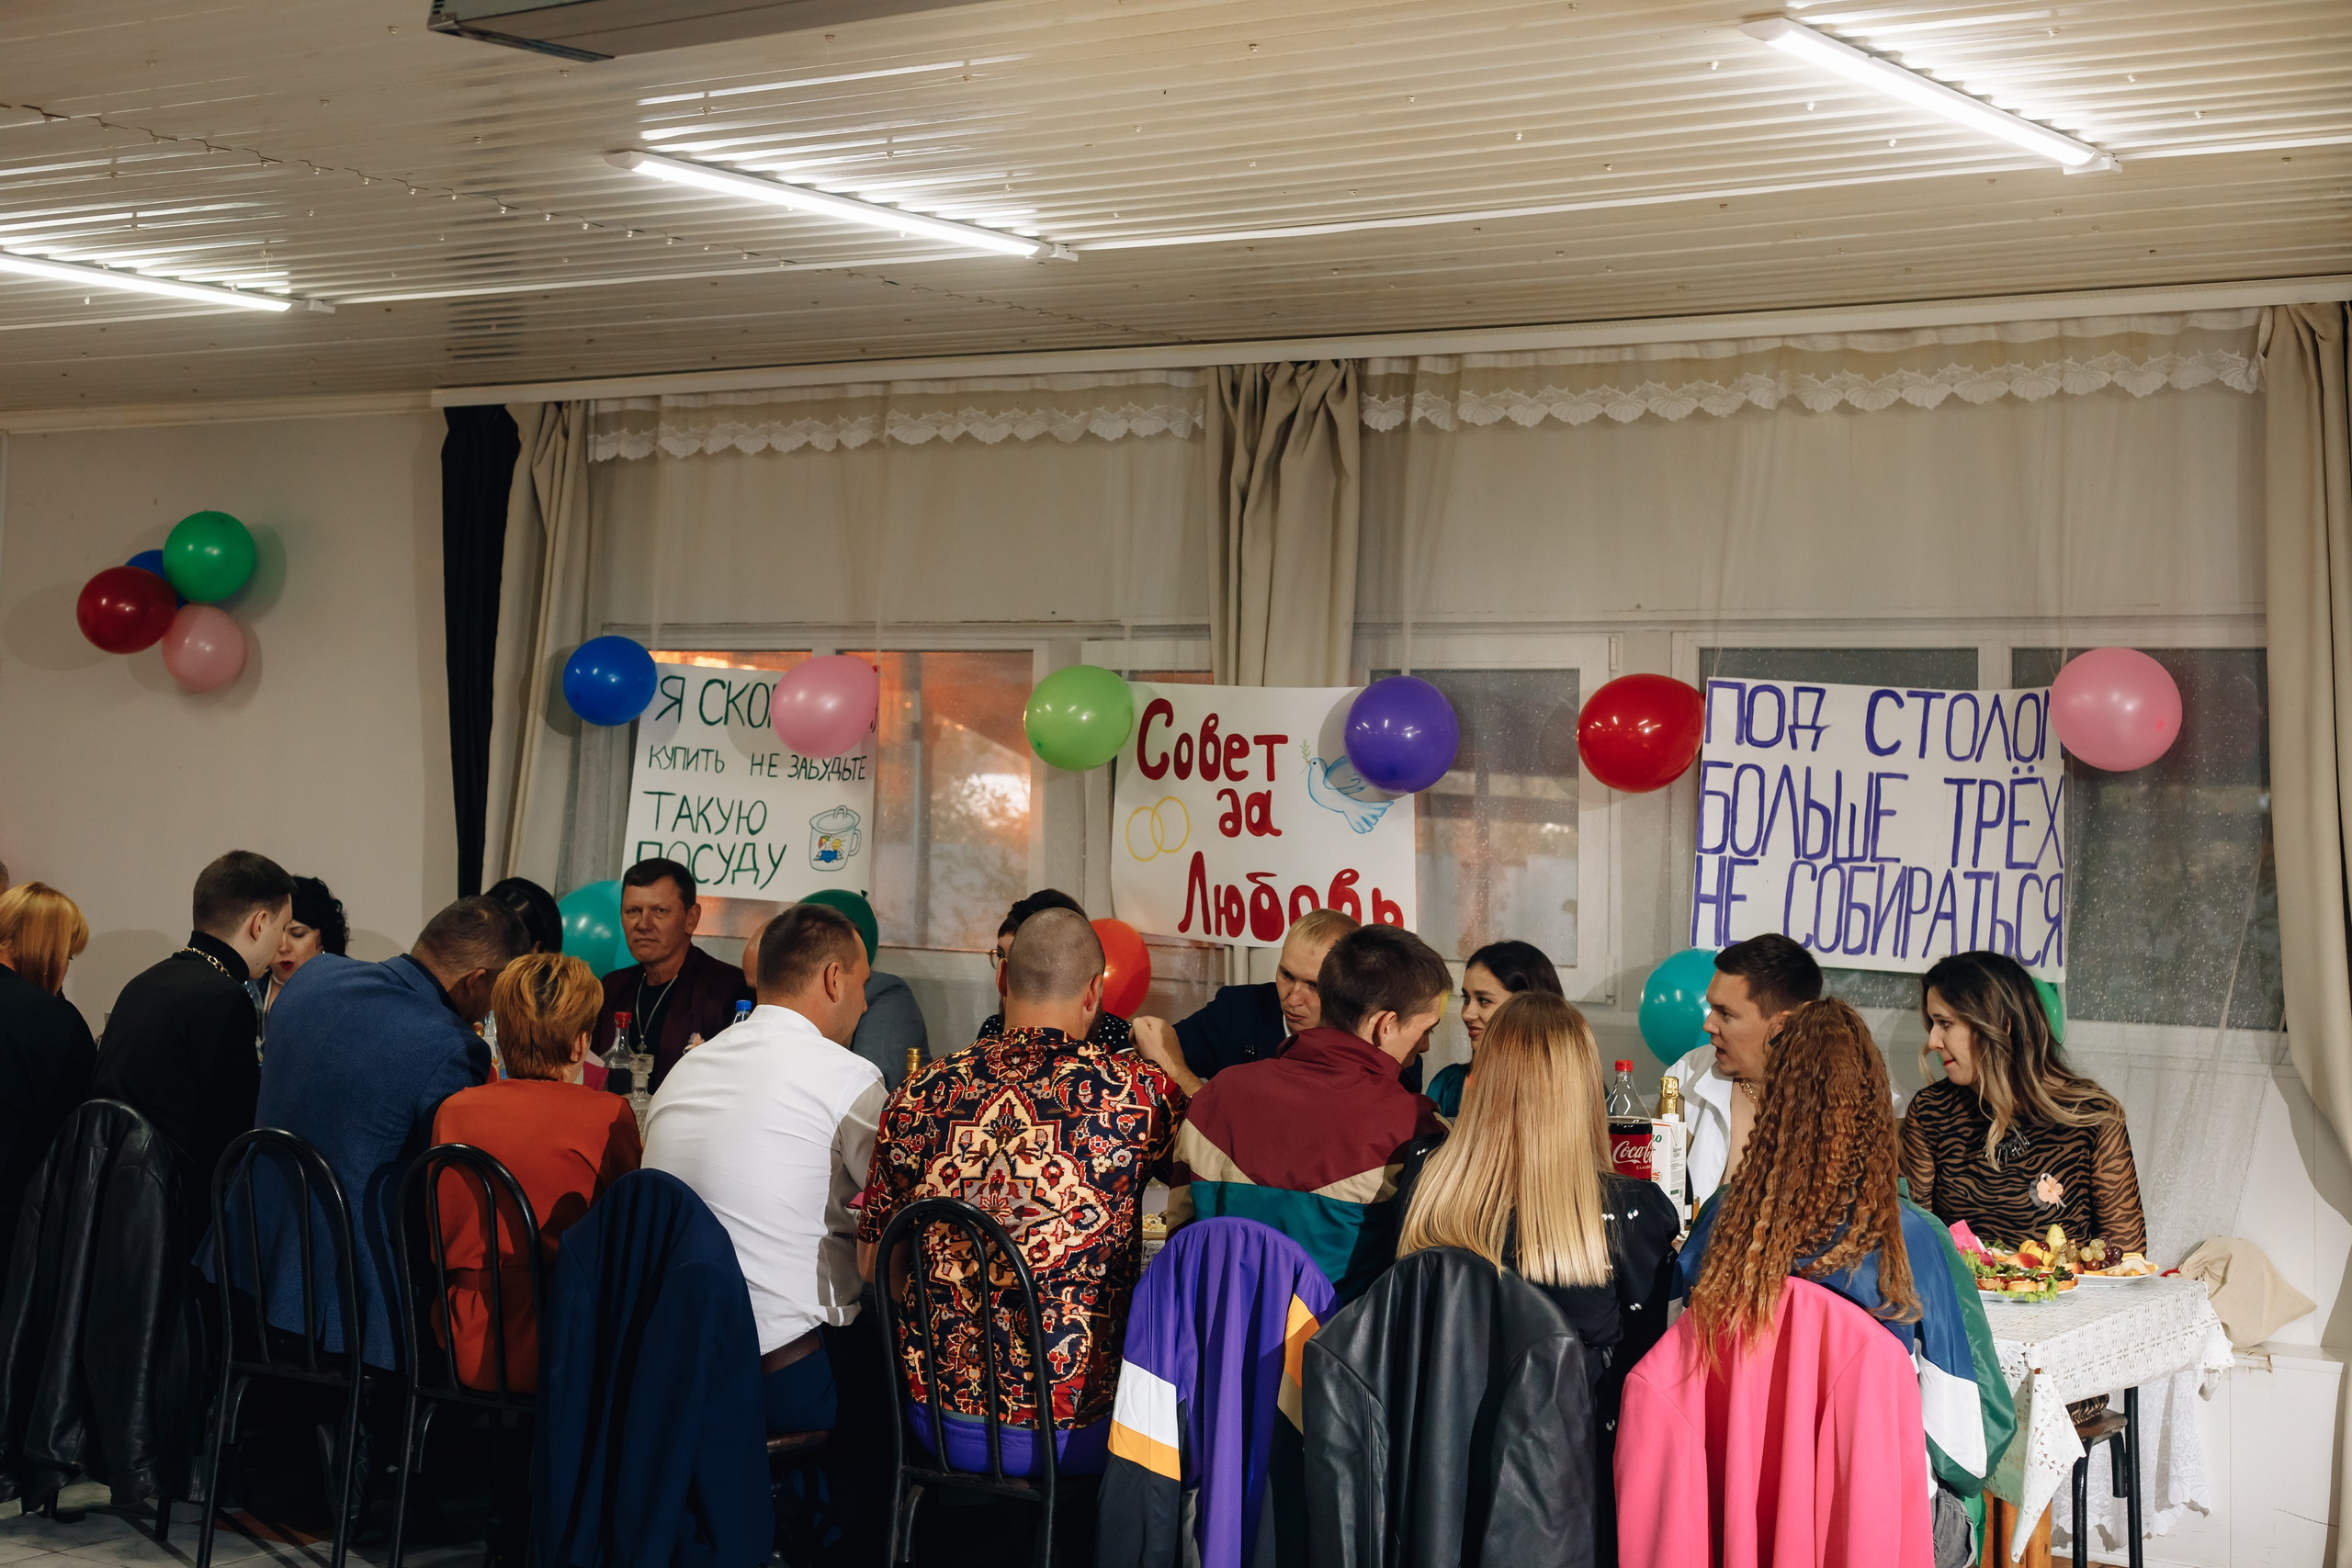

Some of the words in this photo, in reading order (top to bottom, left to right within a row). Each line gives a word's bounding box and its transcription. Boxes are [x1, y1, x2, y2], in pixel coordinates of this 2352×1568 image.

[655, 674, 686, 724] Я
[698, 678, 777, 729] СКО
[1136, 697, 1289, 783] Совет
[1704, 680, 1832, 752] ПОД
[648, 744, 726, 774] КУПИТЬ
[750, 751, 780, 778] НЕ
[642, 790, 768, 836] ТАКУЮ
[1695, 761, 1909, 864] БОЛЬШЕ
[1943, 765, 2064, 870] ТРЁХ
[1177, 851, 1405, 942] Любовь
[1690, 854, 1759, 948] НЕ
[1782, 859, 2064, 968] СОБИРАТЬСЯ
